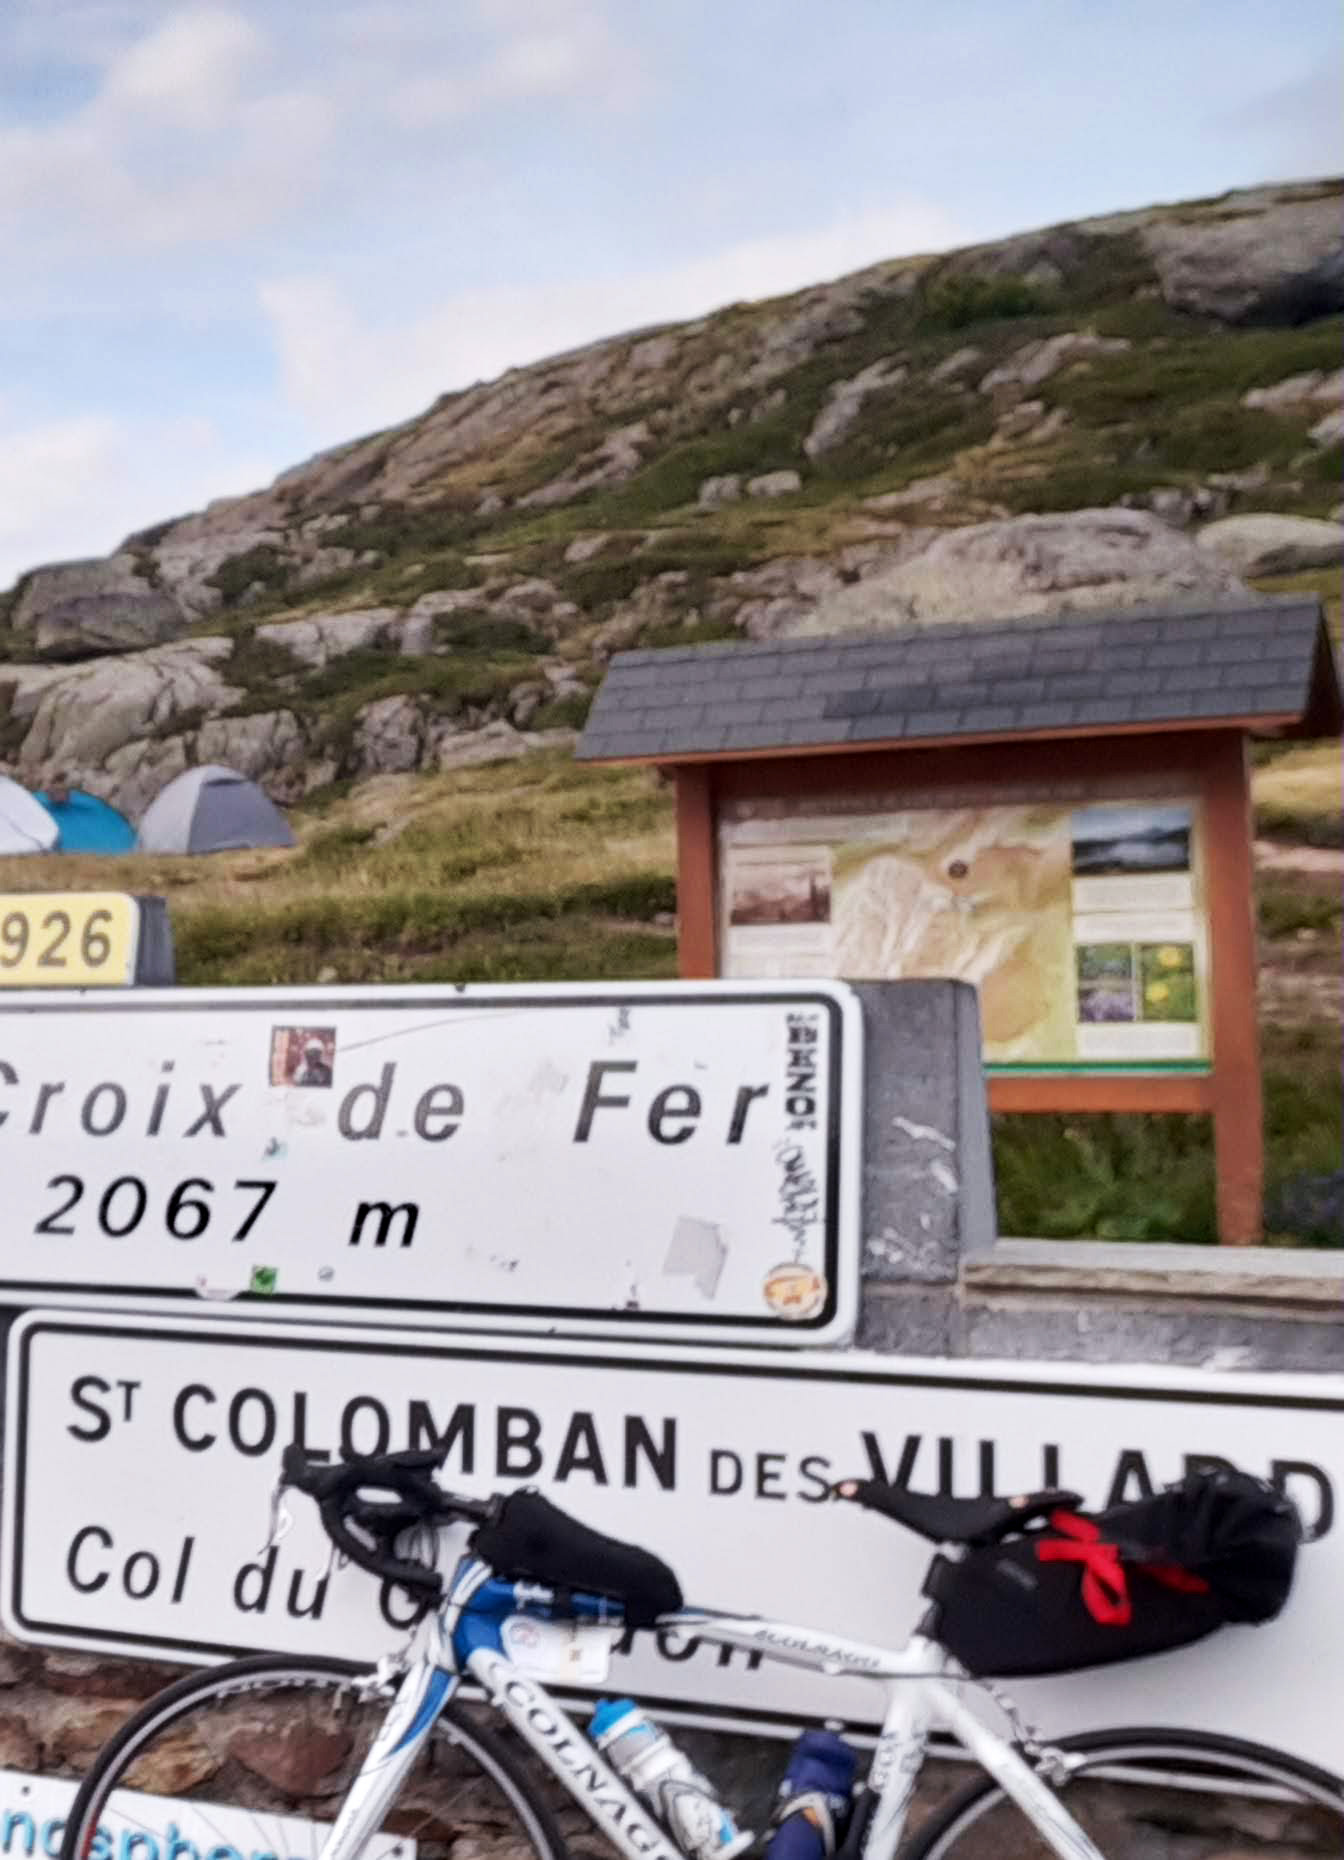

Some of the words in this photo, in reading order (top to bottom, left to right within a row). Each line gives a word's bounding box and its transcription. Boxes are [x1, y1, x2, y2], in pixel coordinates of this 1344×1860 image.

[336, 1060, 467, 1142] de
[572, 1059, 772, 1146] Fer
[32, 1173, 279, 1243] 2067
[346, 1199, 421, 1248] m
[172, 1384, 679, 1491] COLOMBAN
[709, 1447, 835, 1503] DES
[66, 1523, 195, 1605] Col
[234, 1546, 329, 1621] du
[505, 1680, 674, 1860] COLNAG
